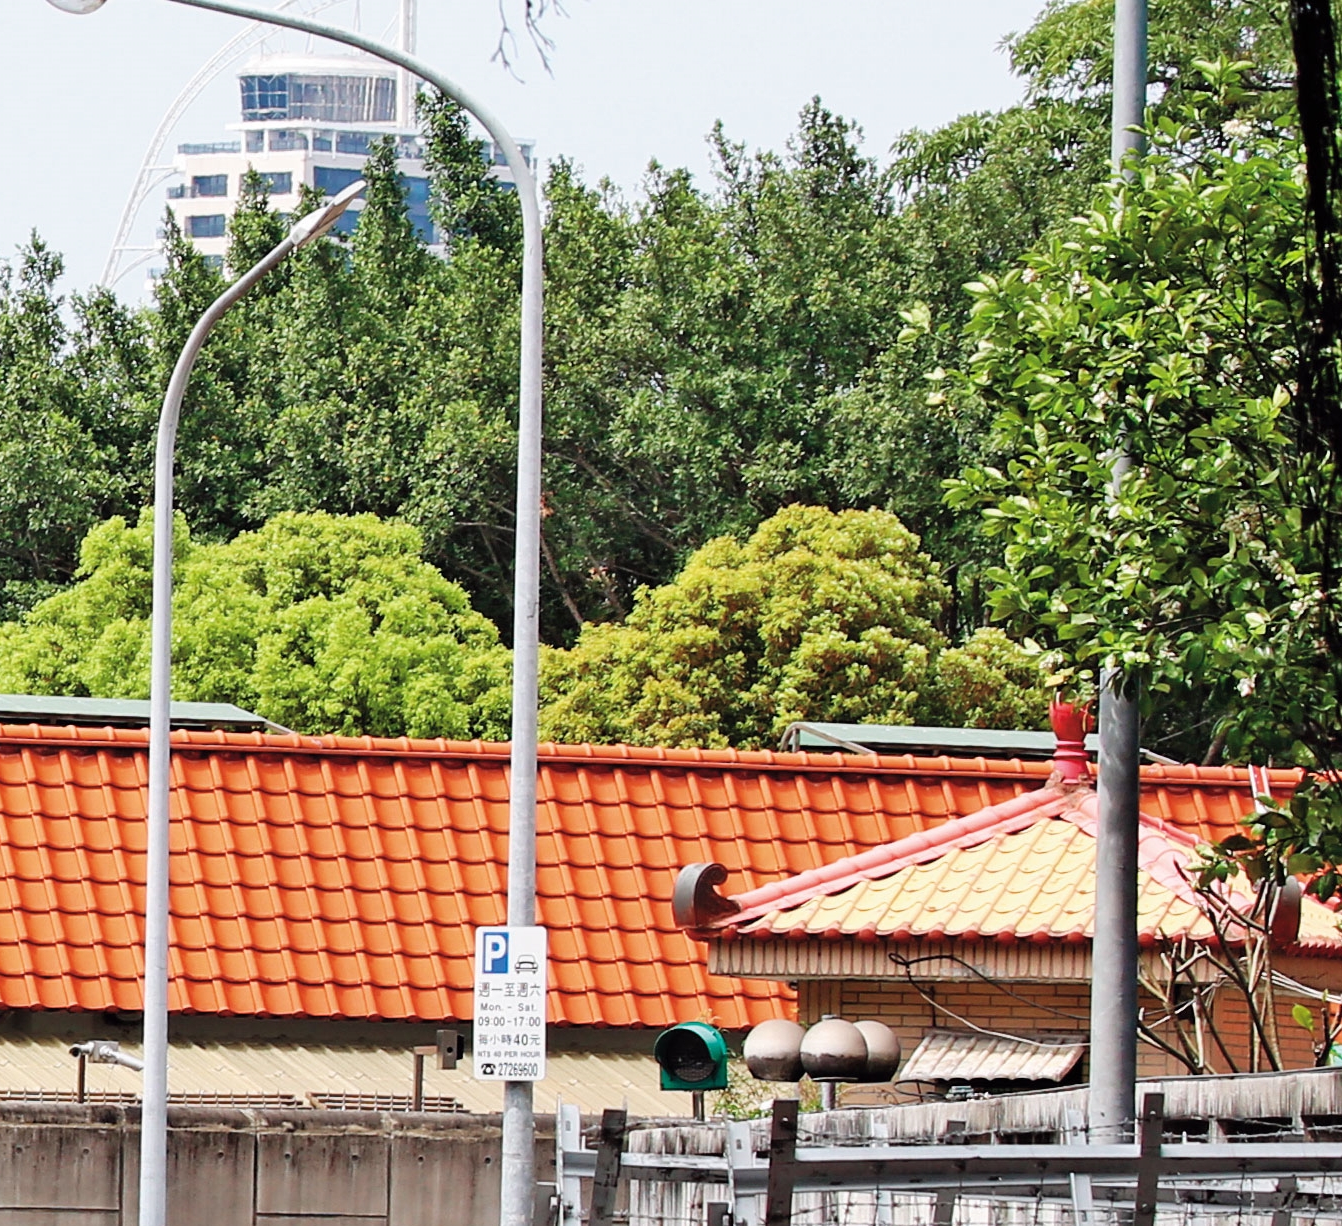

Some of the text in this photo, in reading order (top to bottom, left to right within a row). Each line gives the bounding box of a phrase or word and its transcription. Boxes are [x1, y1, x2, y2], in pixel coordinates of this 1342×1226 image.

[485, 935, 506, 972] P
[478, 982, 541, 997] 週一至週六
[479, 1034, 541, 1046] 每小時40元
